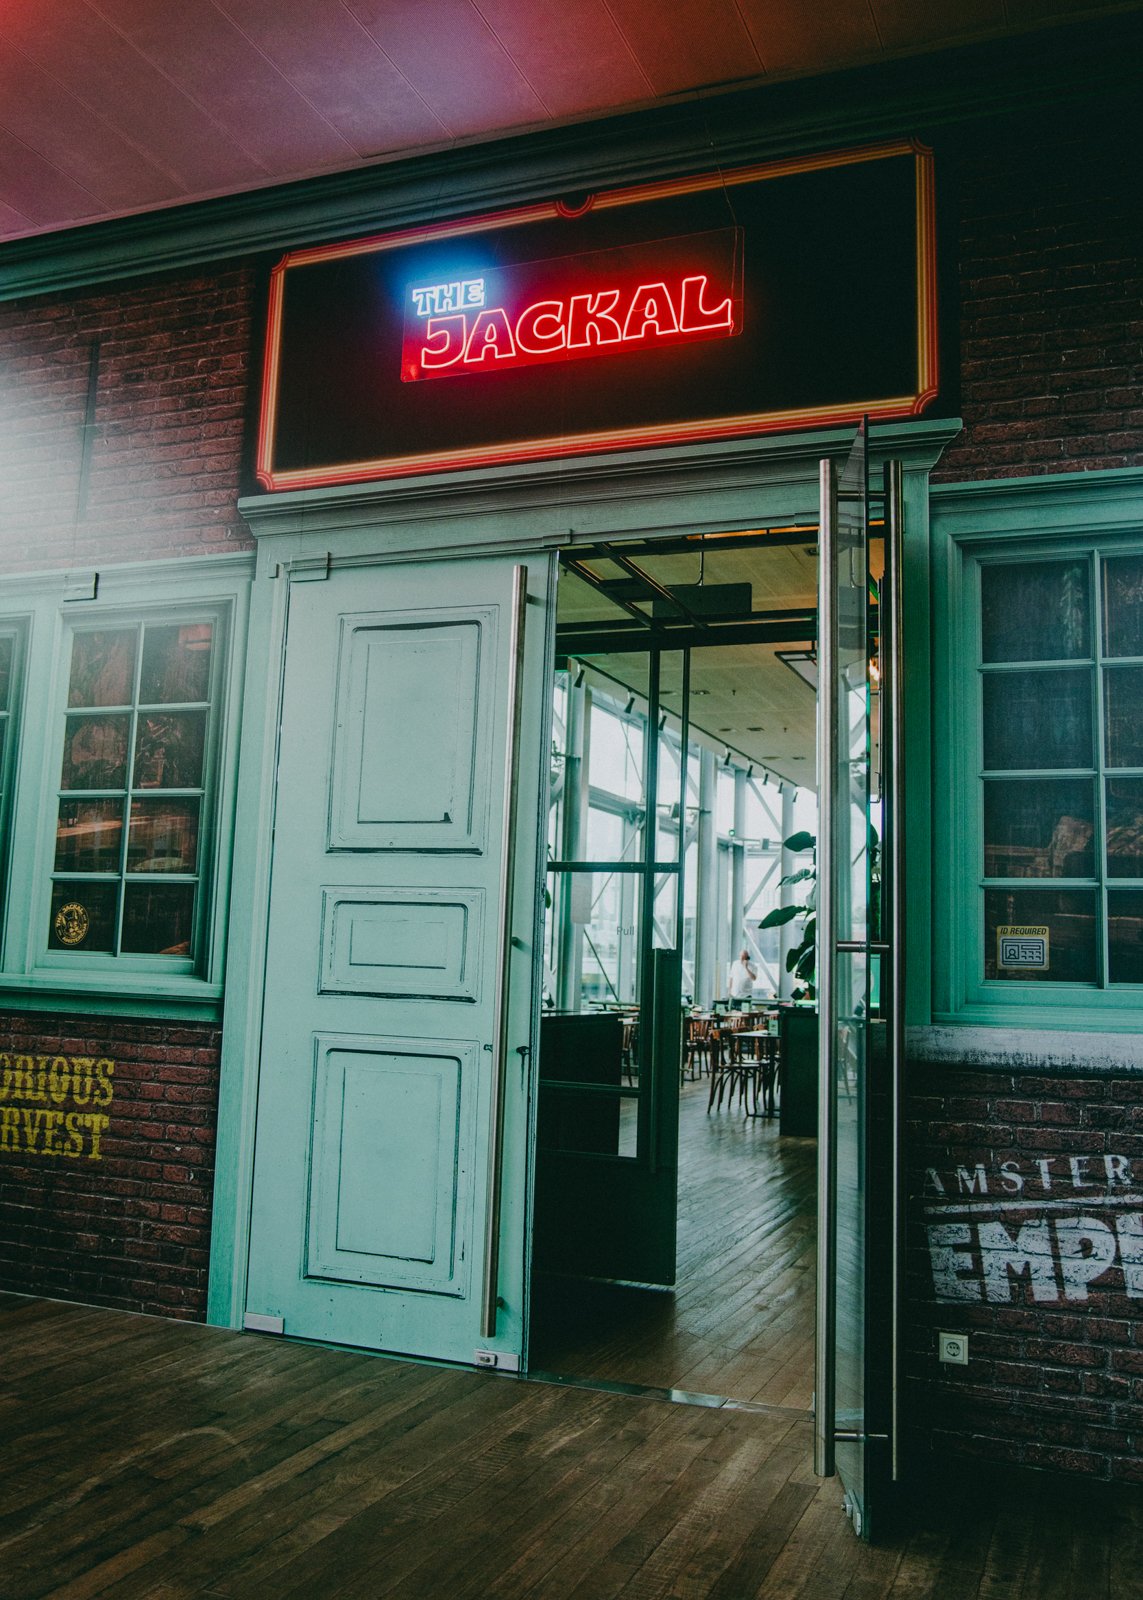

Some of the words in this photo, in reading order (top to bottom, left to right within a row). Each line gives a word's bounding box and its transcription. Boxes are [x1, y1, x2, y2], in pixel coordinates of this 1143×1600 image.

[412, 278, 485, 316] THE
[421, 275, 732, 369] JACKAL
[616, 926, 635, 936] Pull
[1000, 927, 1009, 935] ID
[1010, 927, 1047, 936] REQUIRED
[922, 1154, 1133, 1197] AMSTER
